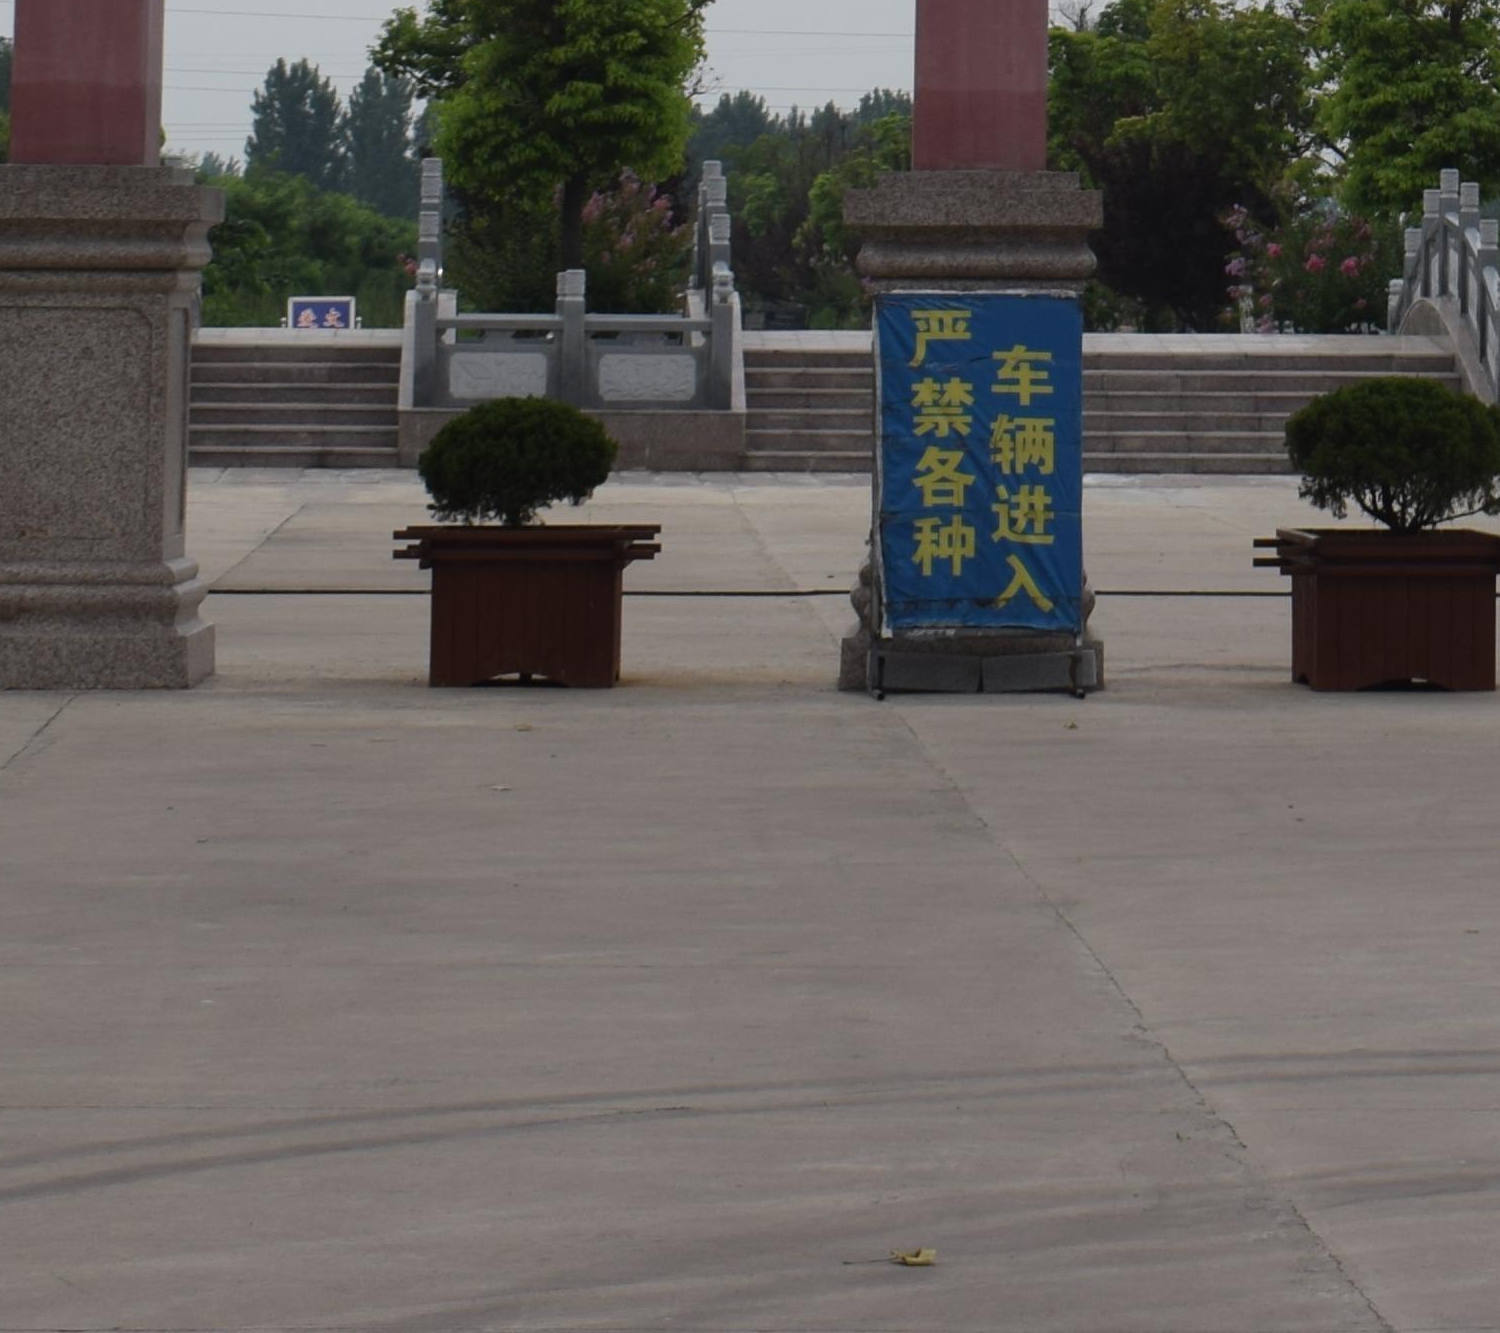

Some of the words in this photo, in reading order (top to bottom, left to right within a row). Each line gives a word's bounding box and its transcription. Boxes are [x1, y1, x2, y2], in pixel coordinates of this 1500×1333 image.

[908, 309, 976, 577] 严禁各种
[989, 344, 1056, 613] 车辆进入
